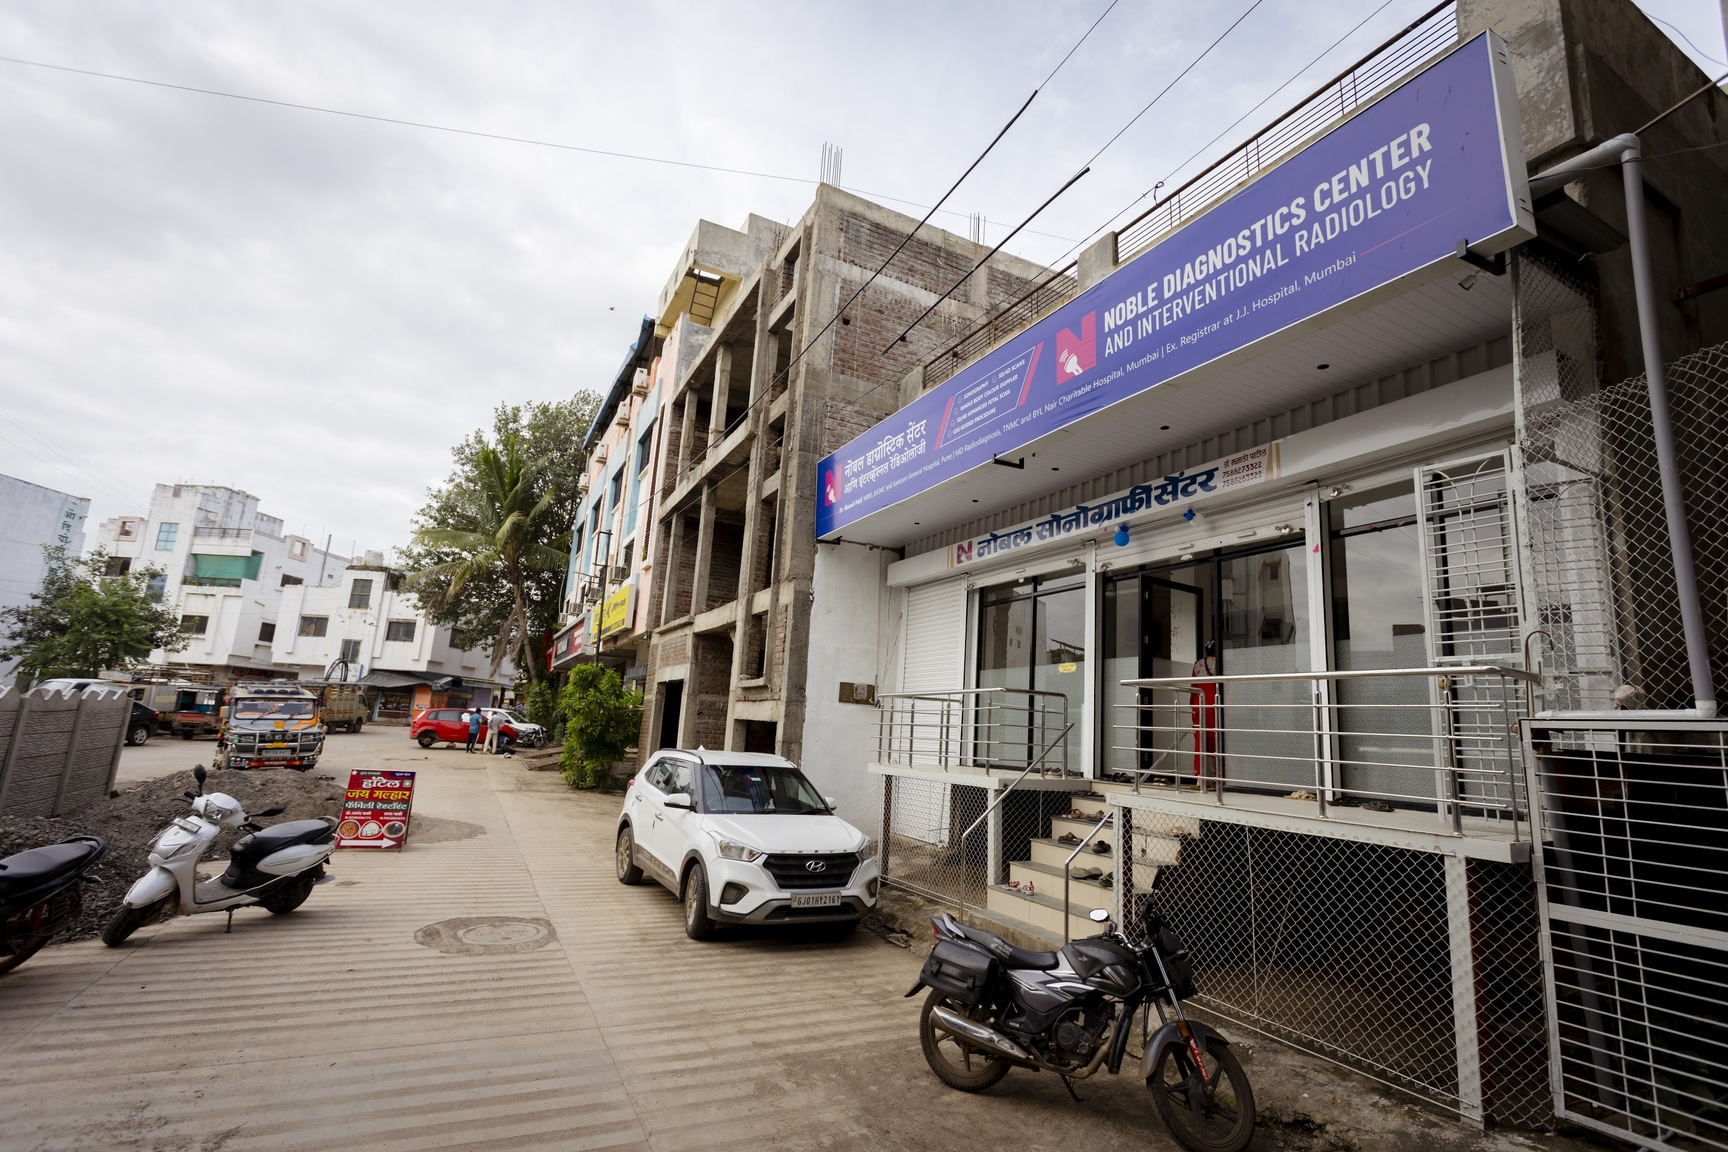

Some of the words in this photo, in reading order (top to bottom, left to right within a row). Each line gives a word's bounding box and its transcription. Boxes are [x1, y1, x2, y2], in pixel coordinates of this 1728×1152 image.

[1104, 282, 1158, 332] NOBLE
[1163, 197, 1307, 300] DIAGNOSTICS
[1313, 122, 1432, 212] CENTER
[1105, 325, 1133, 357] AND
[1137, 243, 1289, 340] INTERVENTIONAL
[1294, 159, 1432, 257] RADIOLOGY
[908, 469, 923, 480] General
[940, 453, 952, 463] Pune
[955, 446, 964, 457] MD
[964, 429, 1001, 452] Radiodiagnosis,
[1003, 419, 1019, 432] TNMC
[1021, 413, 1031, 424] and
[1032, 409, 1043, 419] BYL
[1044, 401, 1057, 413] Nair
[1059, 384, 1092, 405] Charitable
[1093, 367, 1125, 389] Hospital,
[1126, 348, 1160, 373] Mumbai
[1166, 342, 1179, 354] Ex.
[1180, 320, 1221, 347] Registrar
[1223, 313, 1234, 326] at
[1235, 306, 1250, 321] J.J.
[1252, 280, 1301, 312] Hospital,
[1304, 251, 1357, 287] Mumbai
[844, 456, 865, 477] नोबल
[906, 419, 927, 443] सेंटर
[844, 477, 858, 494] आणि
[976, 526, 1033, 559] नोबल
[1035, 484, 1153, 543] सोनोग्राफी
[1154, 467, 1219, 509] सेंटर
[347, 789, 371, 799] जय
[373, 790, 411, 800] मल्हार
